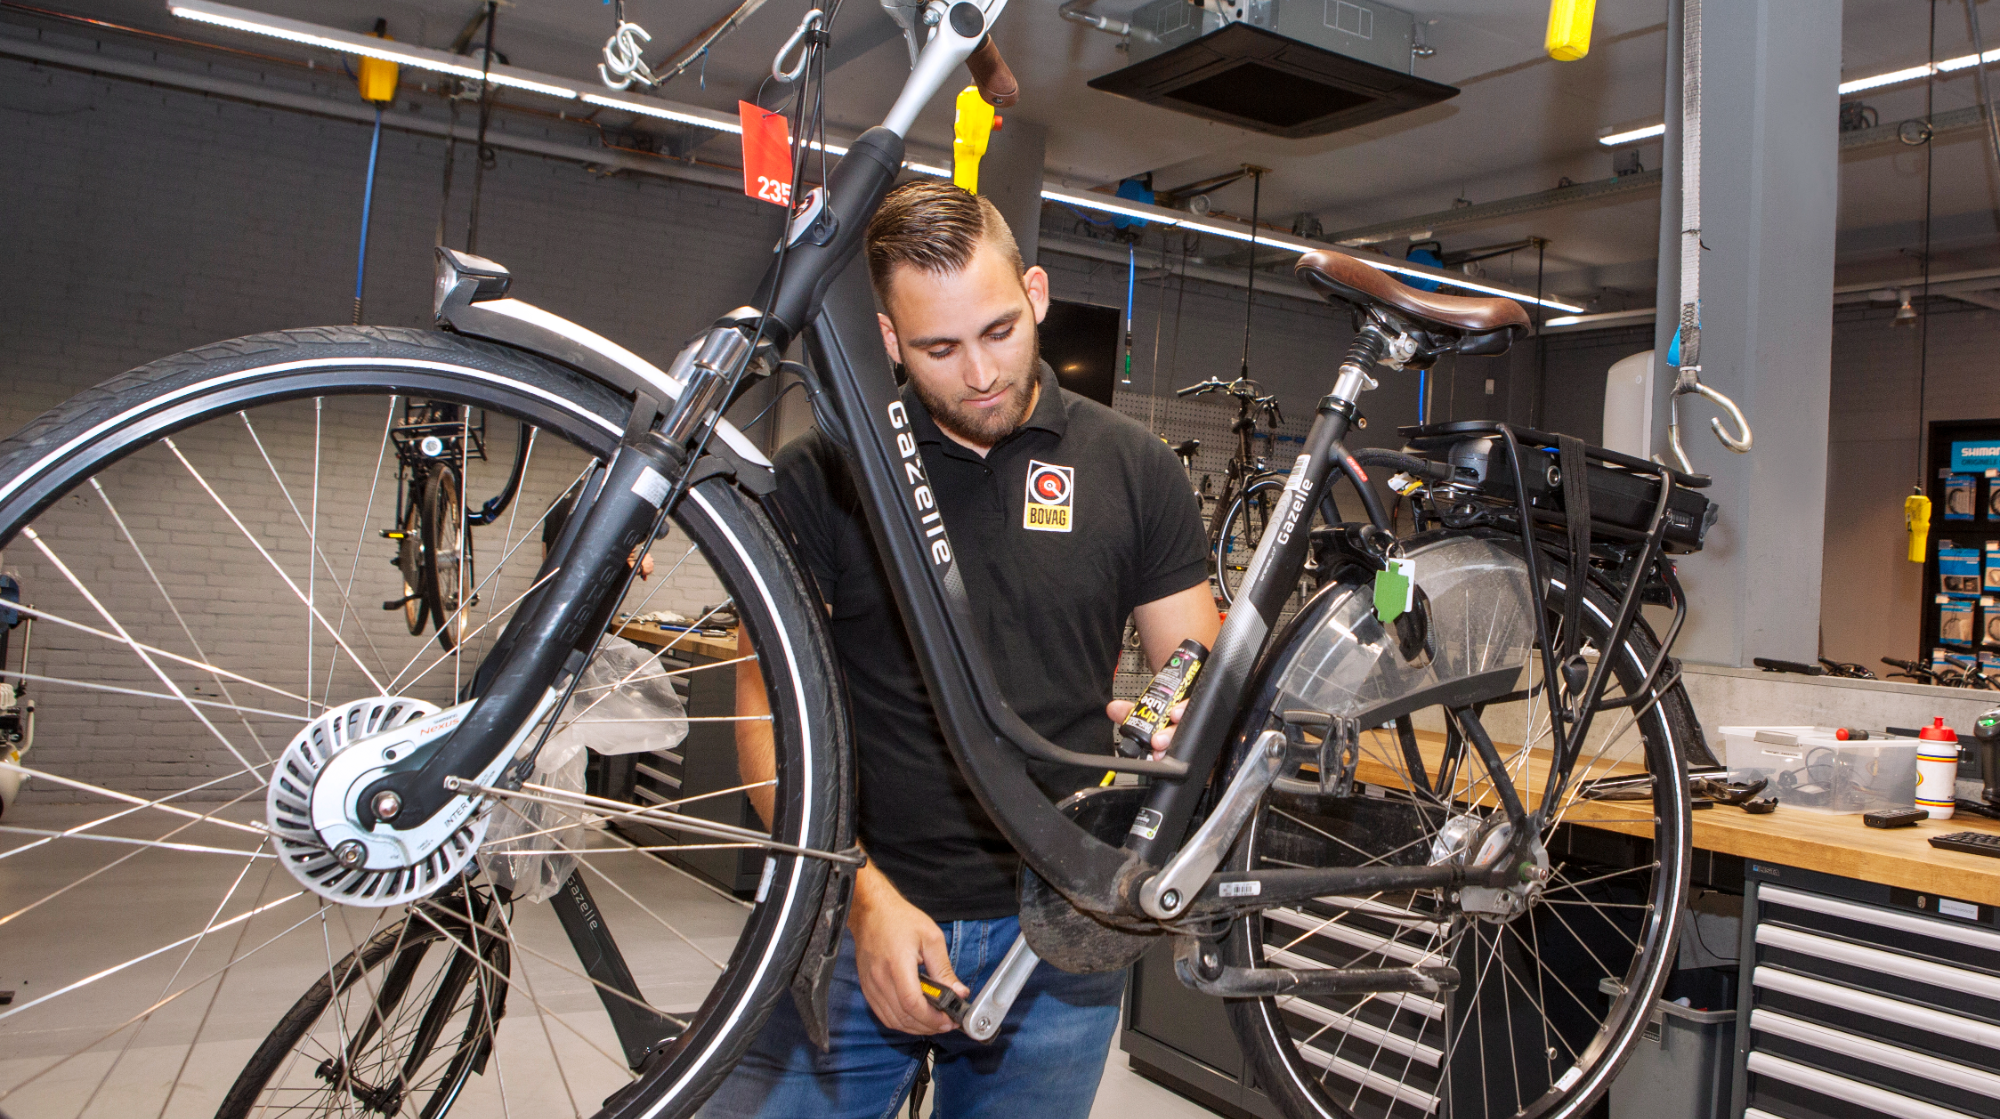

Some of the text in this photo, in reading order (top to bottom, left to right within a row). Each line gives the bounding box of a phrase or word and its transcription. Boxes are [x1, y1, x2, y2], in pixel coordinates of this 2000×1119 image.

[757, 175, 792, 207] 235
[887, 400, 951, 565] Gazelle
[1030, 507, 1066, 526] BOVAG
[1277, 478, 1313, 545] Gazelle
[560, 529, 640, 643] Gazelle
[1137, 706, 1159, 723] dry
[1140, 695, 1167, 714] lube
[420, 717, 460, 737] Nexus
[444, 801, 469, 828] INTER
[566, 874, 599, 930] Gazelle
